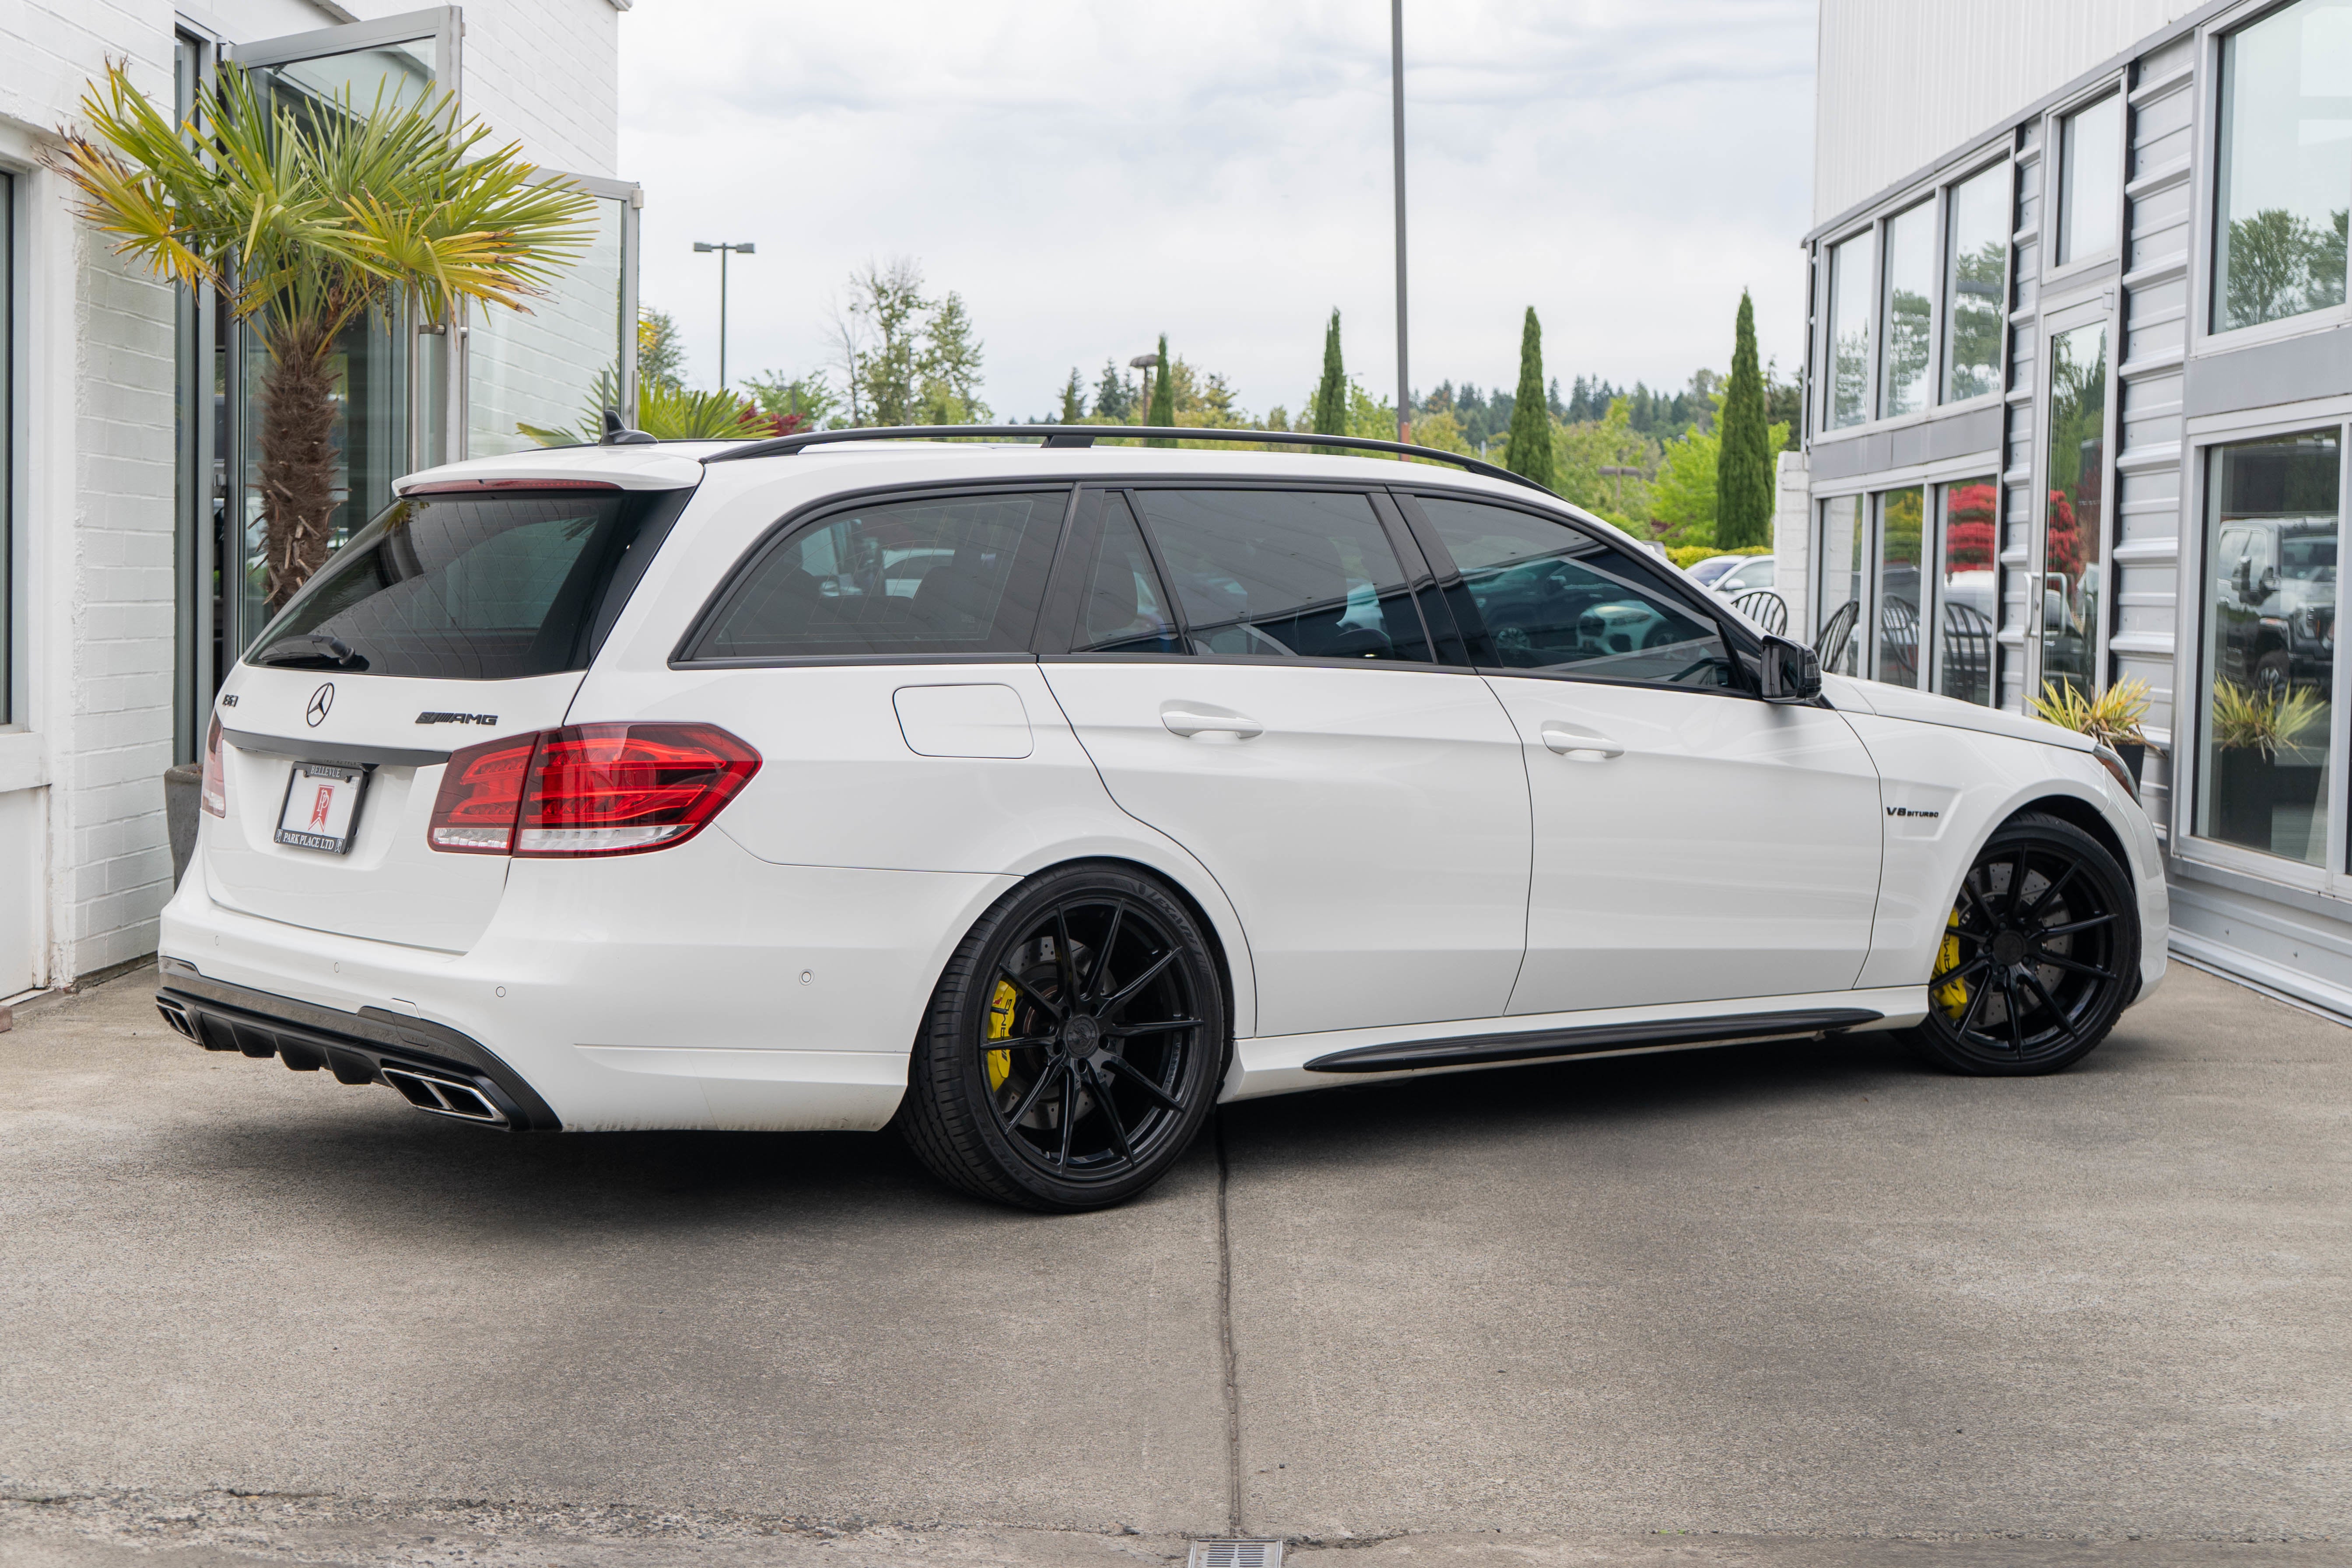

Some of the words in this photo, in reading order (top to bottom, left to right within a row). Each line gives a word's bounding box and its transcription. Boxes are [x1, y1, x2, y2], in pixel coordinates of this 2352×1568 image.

[448, 713, 498, 726] AMG
[310, 765, 341, 778] BELLEVUE
[1886, 807, 1906, 816] V8
[283, 832, 300, 844] PARK
[299, 835, 319, 848] PLACE
[320, 838, 334, 850] LTD
